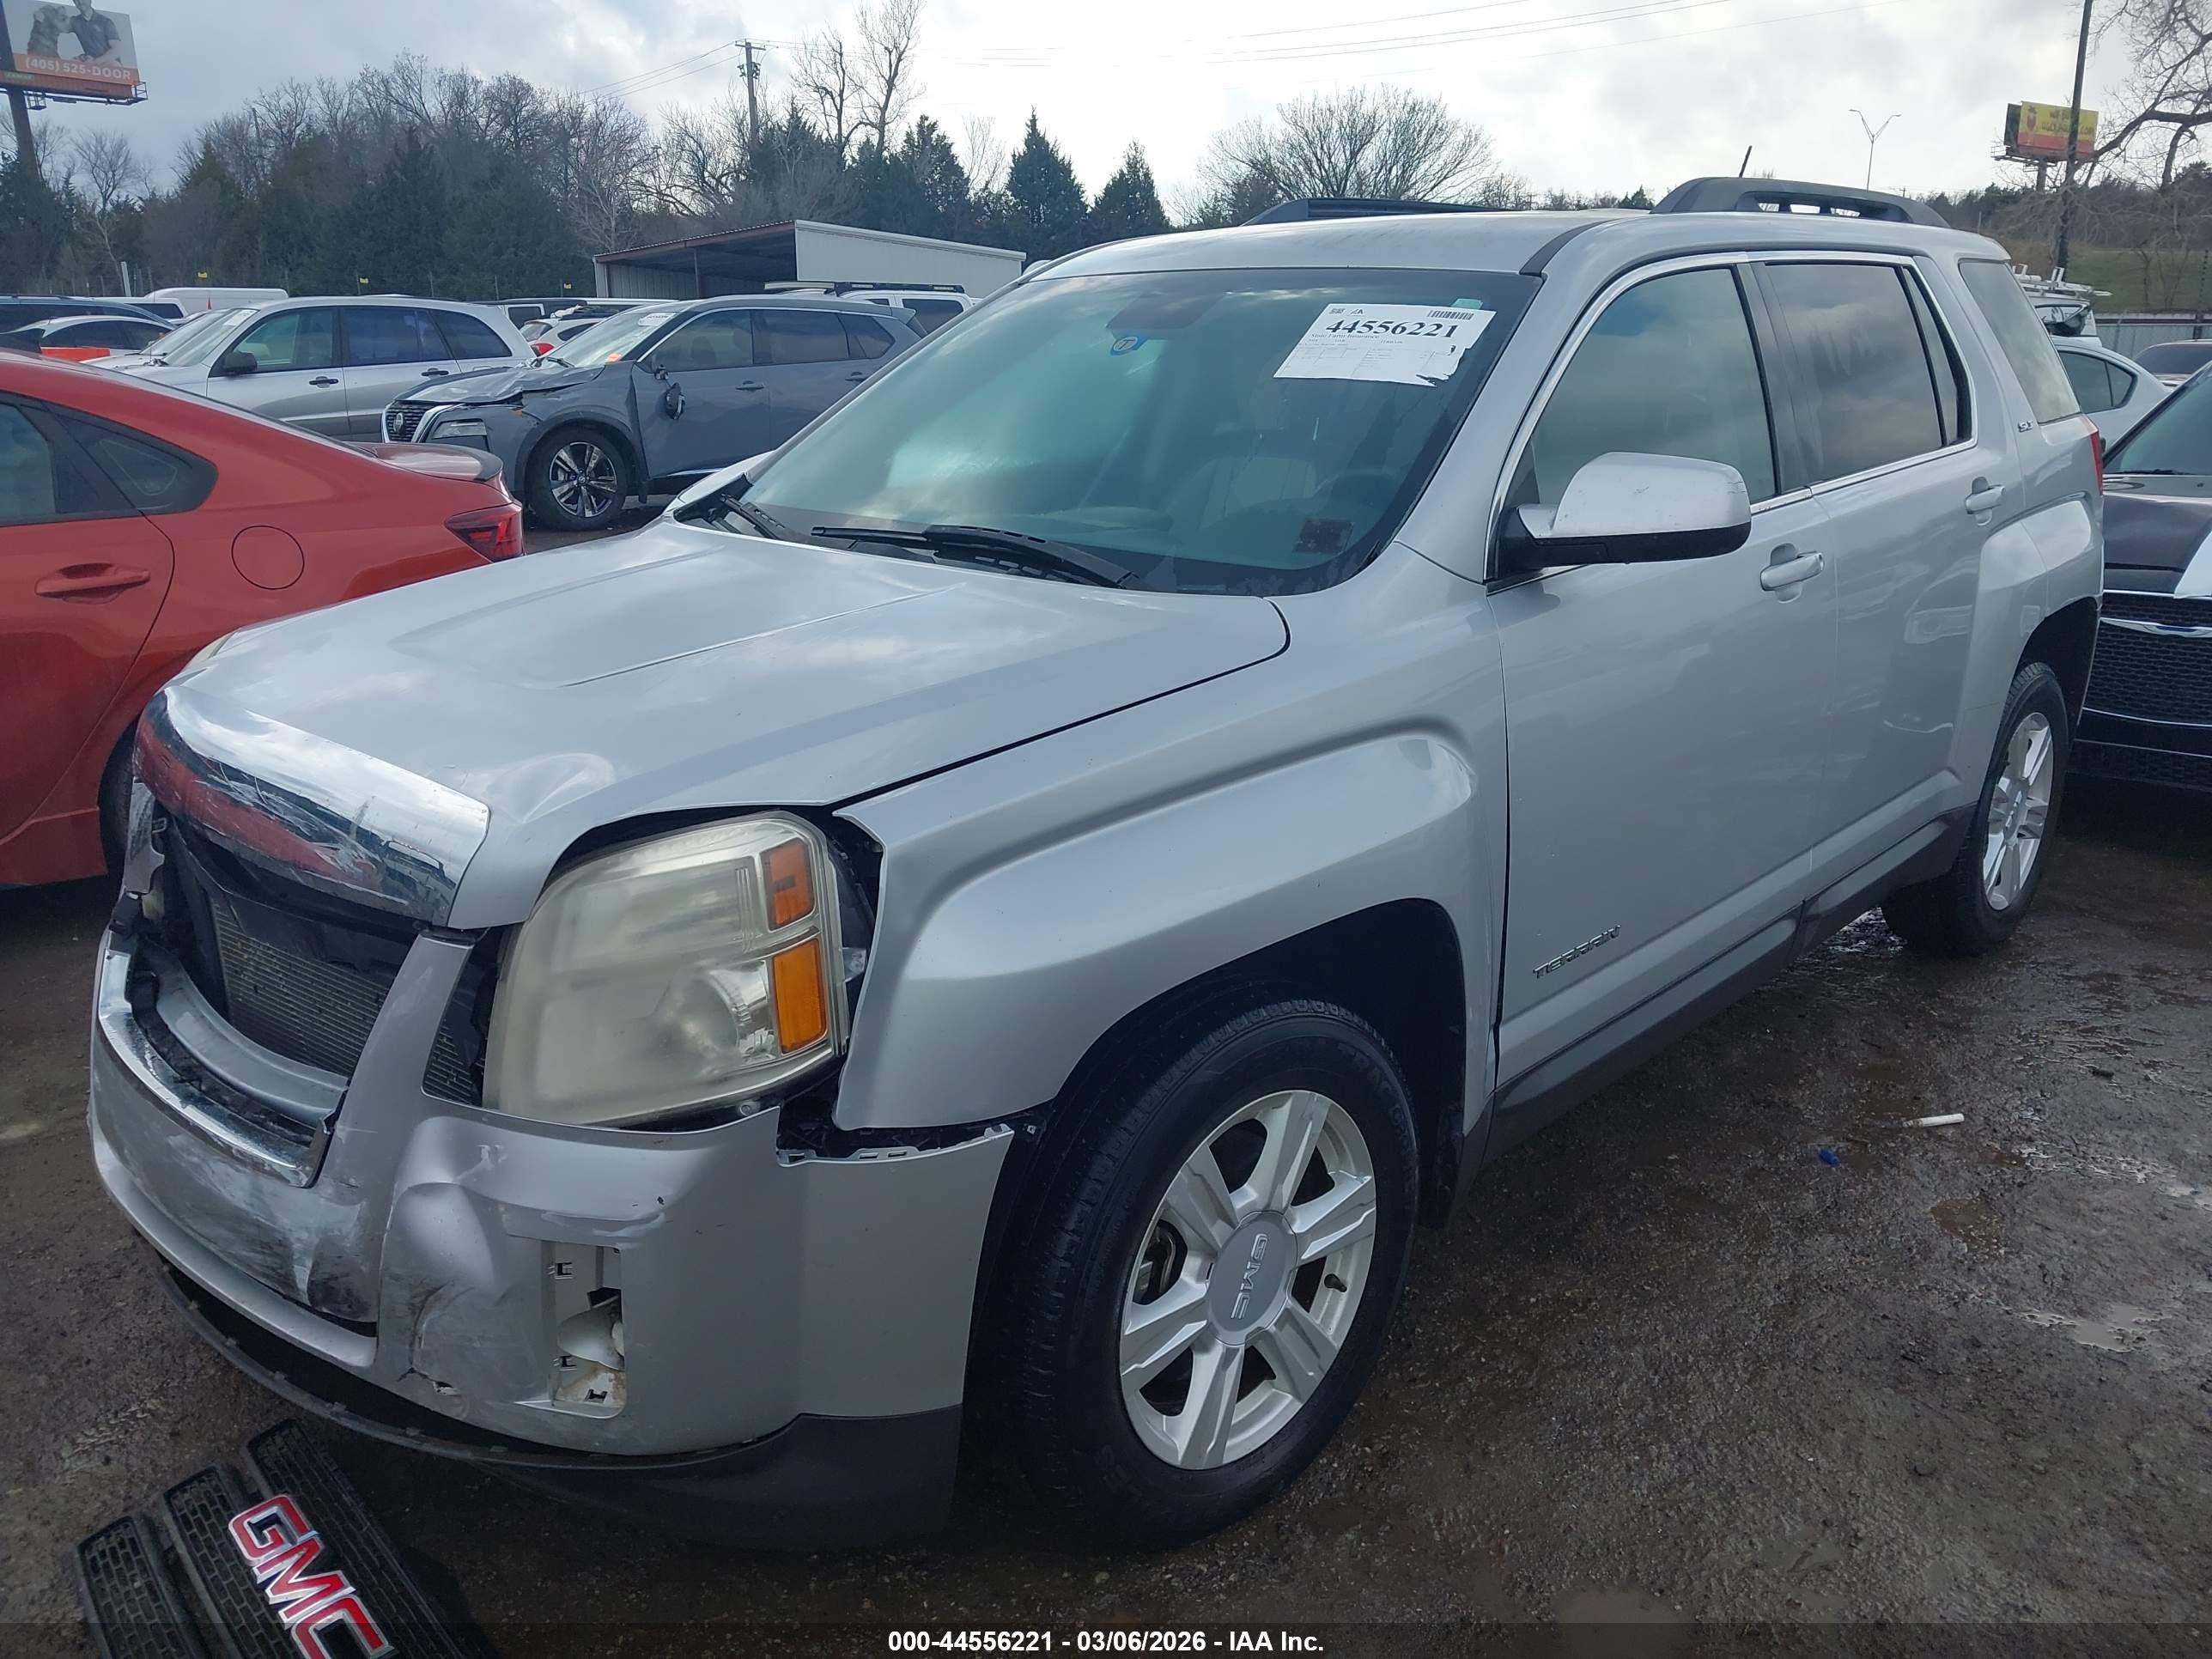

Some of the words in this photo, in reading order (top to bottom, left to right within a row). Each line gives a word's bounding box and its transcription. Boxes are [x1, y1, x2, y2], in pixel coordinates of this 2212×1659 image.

[26, 57, 59, 73] (405)
[63, 62, 131, 80] 525-DOOR
[1326, 319, 1458, 338] 44556221
[1533, 924, 1621, 979] TERRAIN
[1231, 1233, 1268, 1320] GMC
[228, 1494, 394, 1659] GMC
